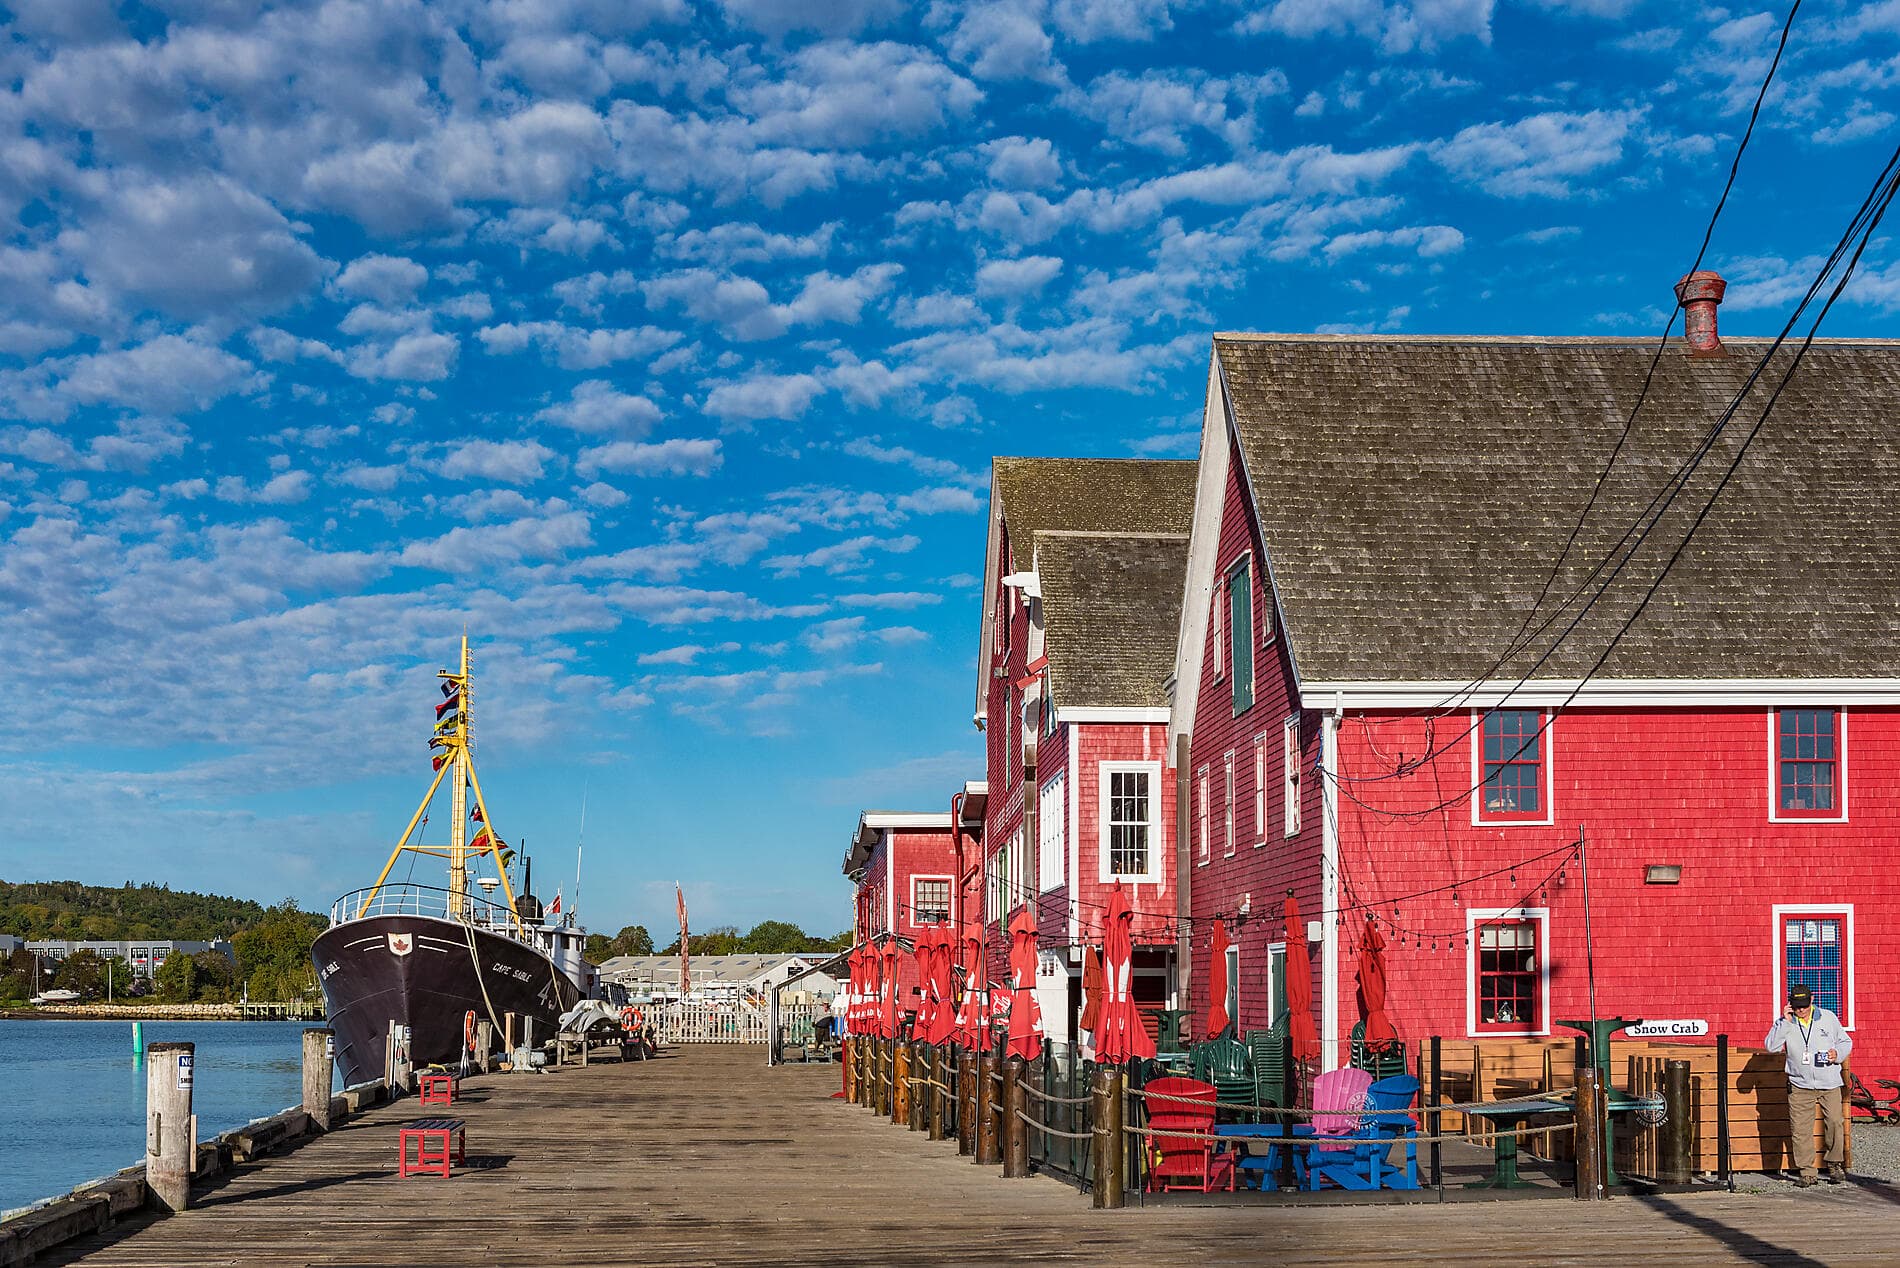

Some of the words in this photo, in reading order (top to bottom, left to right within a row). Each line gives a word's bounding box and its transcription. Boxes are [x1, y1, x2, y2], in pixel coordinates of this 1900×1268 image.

[493, 963, 511, 975] CAPE
[512, 970, 532, 983] SABLE
[1634, 1024, 1668, 1034] Snow
[1671, 1022, 1700, 1034] Crab
